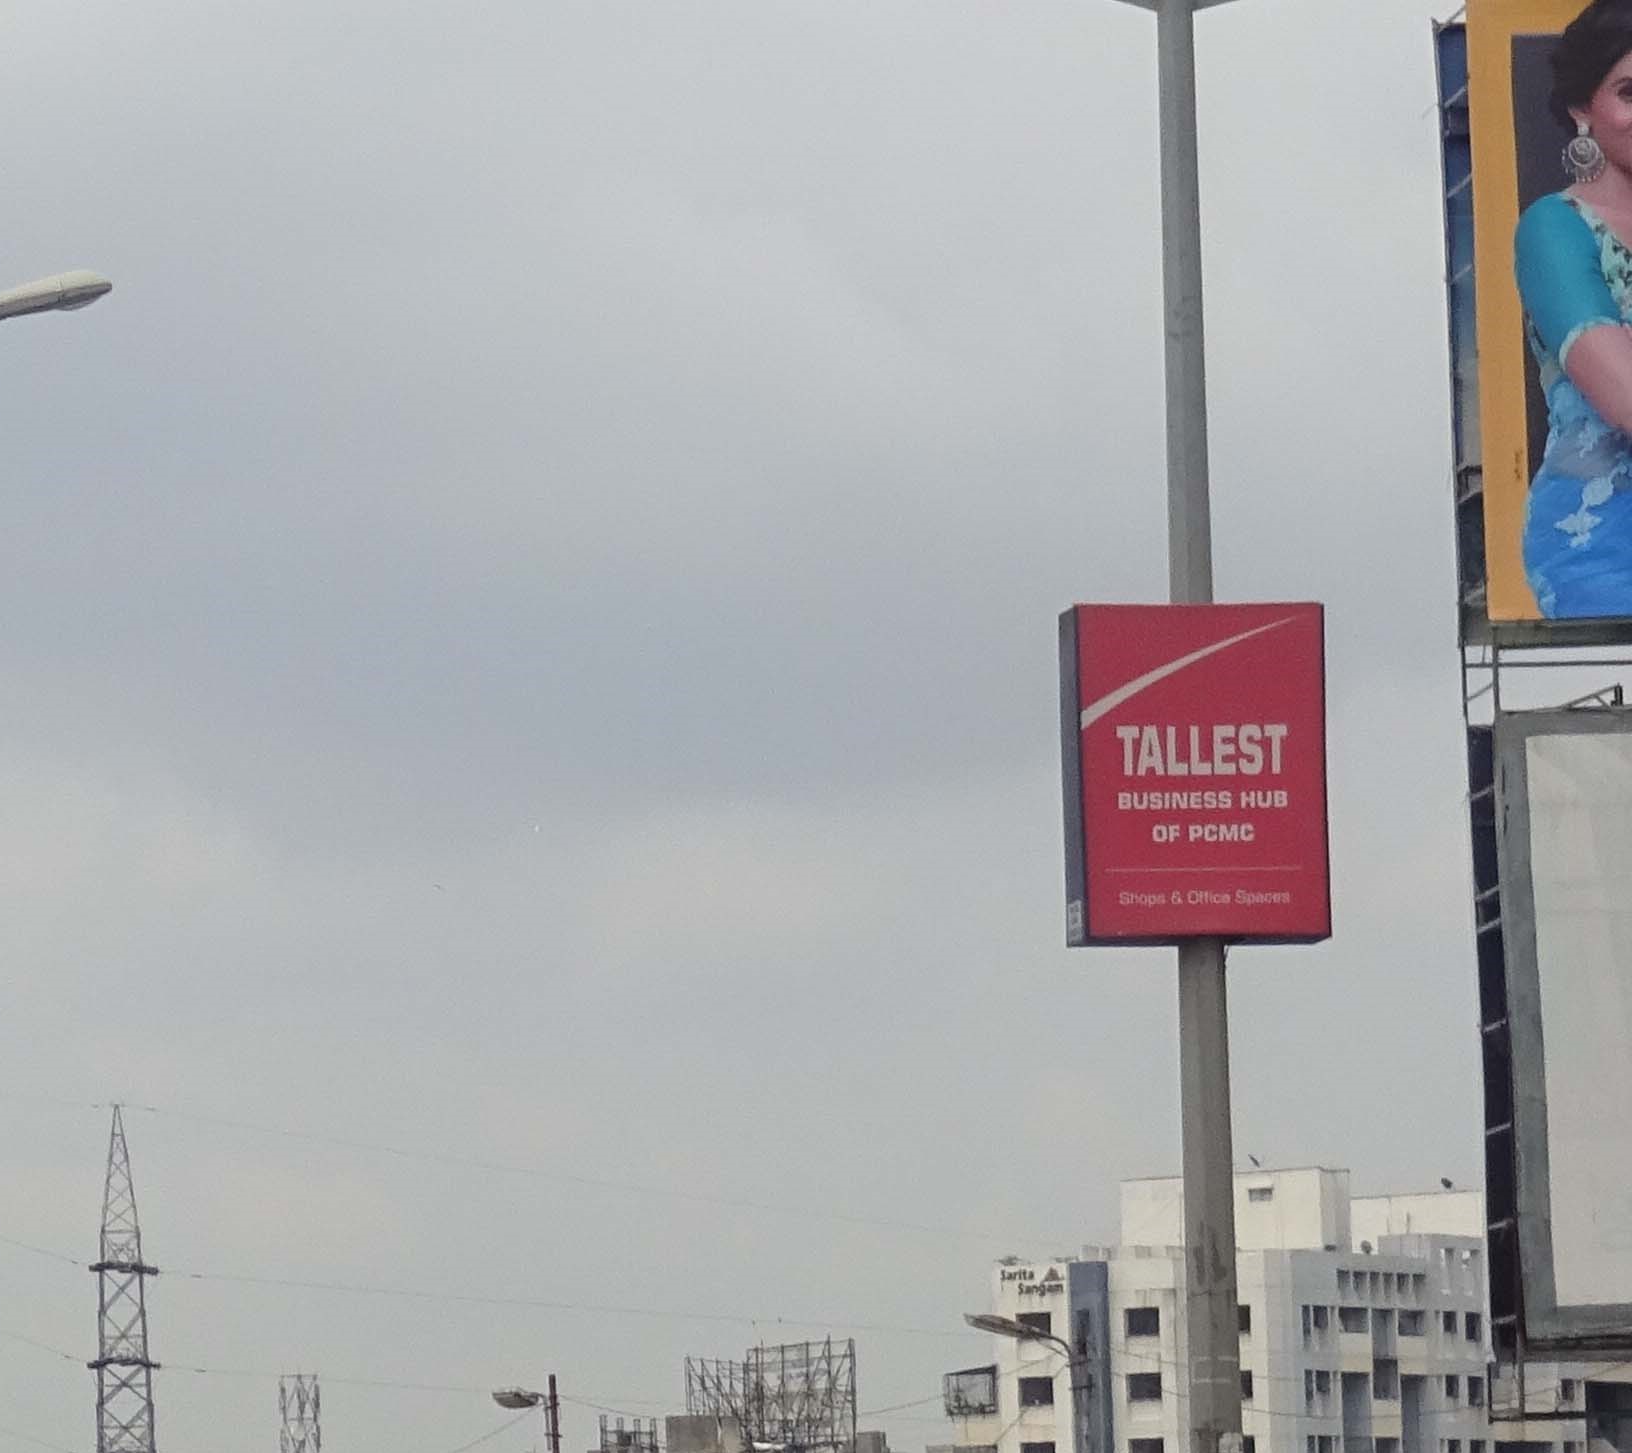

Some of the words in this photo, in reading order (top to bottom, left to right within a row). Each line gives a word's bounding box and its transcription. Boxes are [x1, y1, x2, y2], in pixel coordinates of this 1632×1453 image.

[1116, 723, 1288, 777] TALLEST
[1118, 792, 1232, 810] BUSINESS
[1241, 790, 1288, 808] HUB
[1153, 824, 1180, 842] OF
[1189, 824, 1255, 841] PCMC
[1119, 890, 1166, 908] Shops
[1172, 892, 1183, 904] &
[1188, 890, 1231, 904] Office
[1235, 889, 1290, 906] Spaces
[1000, 1269, 1034, 1280] Sarita
